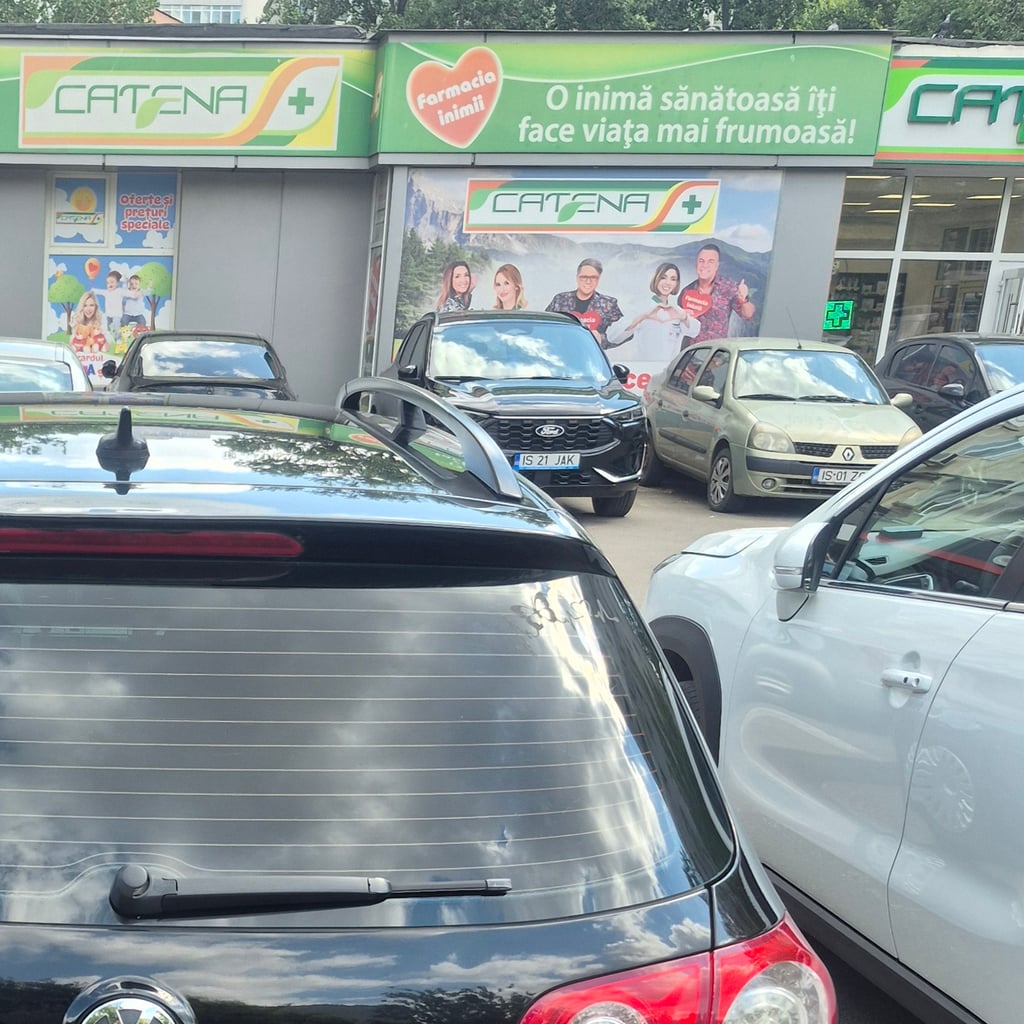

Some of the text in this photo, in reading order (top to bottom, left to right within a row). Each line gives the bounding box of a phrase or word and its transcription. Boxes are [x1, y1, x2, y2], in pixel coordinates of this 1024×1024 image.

[55, 85, 247, 115] CATENA
[417, 70, 496, 110] Farmacia
[546, 84, 568, 110] O
[576, 84, 652, 111] inimă
[660, 85, 800, 112] sănătoasă
[437, 94, 485, 126] inimii
[519, 116, 575, 143] face
[657, 117, 709, 143] mai
[715, 116, 857, 144] frumoasă!
[120, 194, 161, 205] Oferte
[492, 193, 649, 213] CATENA
[121, 219, 169, 231] speciale
[537, 455, 548, 466] 21
[555, 454, 576, 466] JAK
